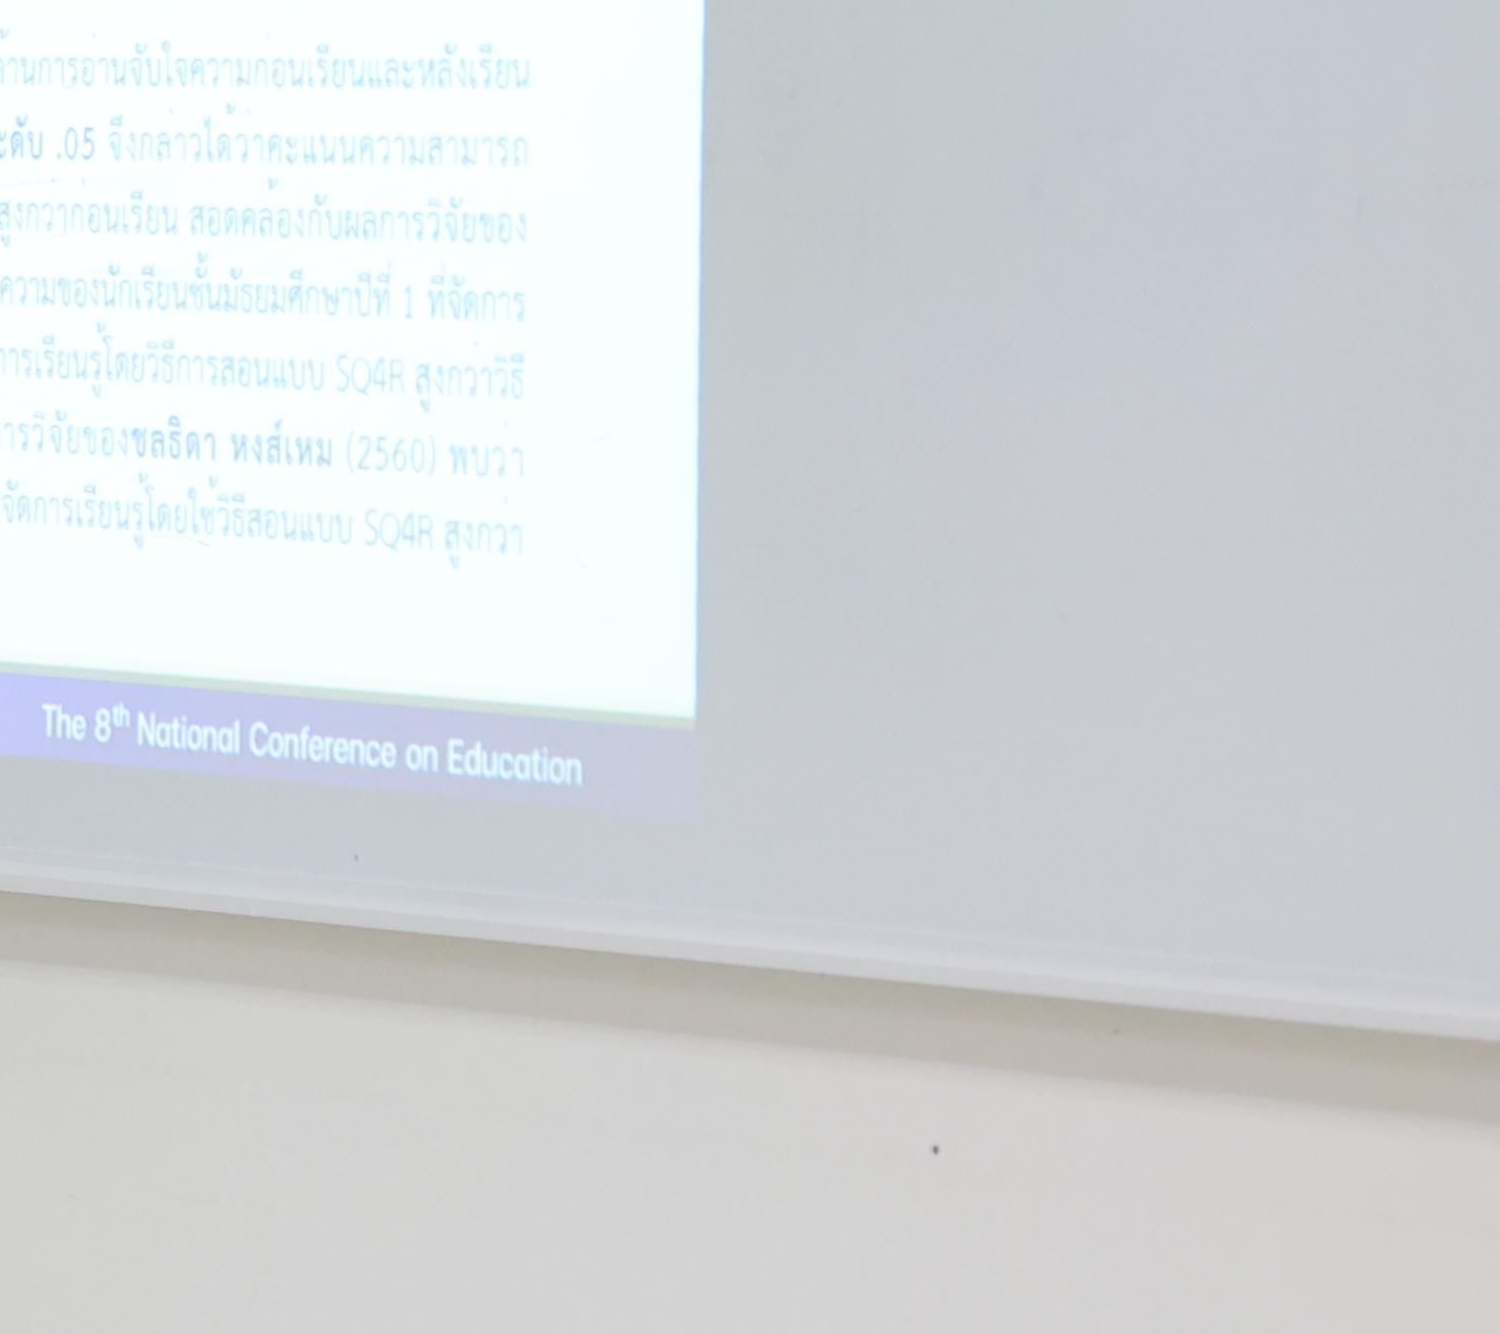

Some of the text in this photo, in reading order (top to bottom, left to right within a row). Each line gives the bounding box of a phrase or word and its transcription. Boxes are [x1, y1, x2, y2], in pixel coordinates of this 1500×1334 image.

[56, 126, 95, 161] .05
[336, 354, 403, 396] SQ4R
[347, 435, 436, 472] (2560)
[365, 508, 432, 551] SQ4R
[42, 702, 88, 744] The
[137, 713, 241, 761] National
[249, 721, 397, 771] Conference
[406, 744, 438, 773] on
[447, 740, 583, 787] Education
